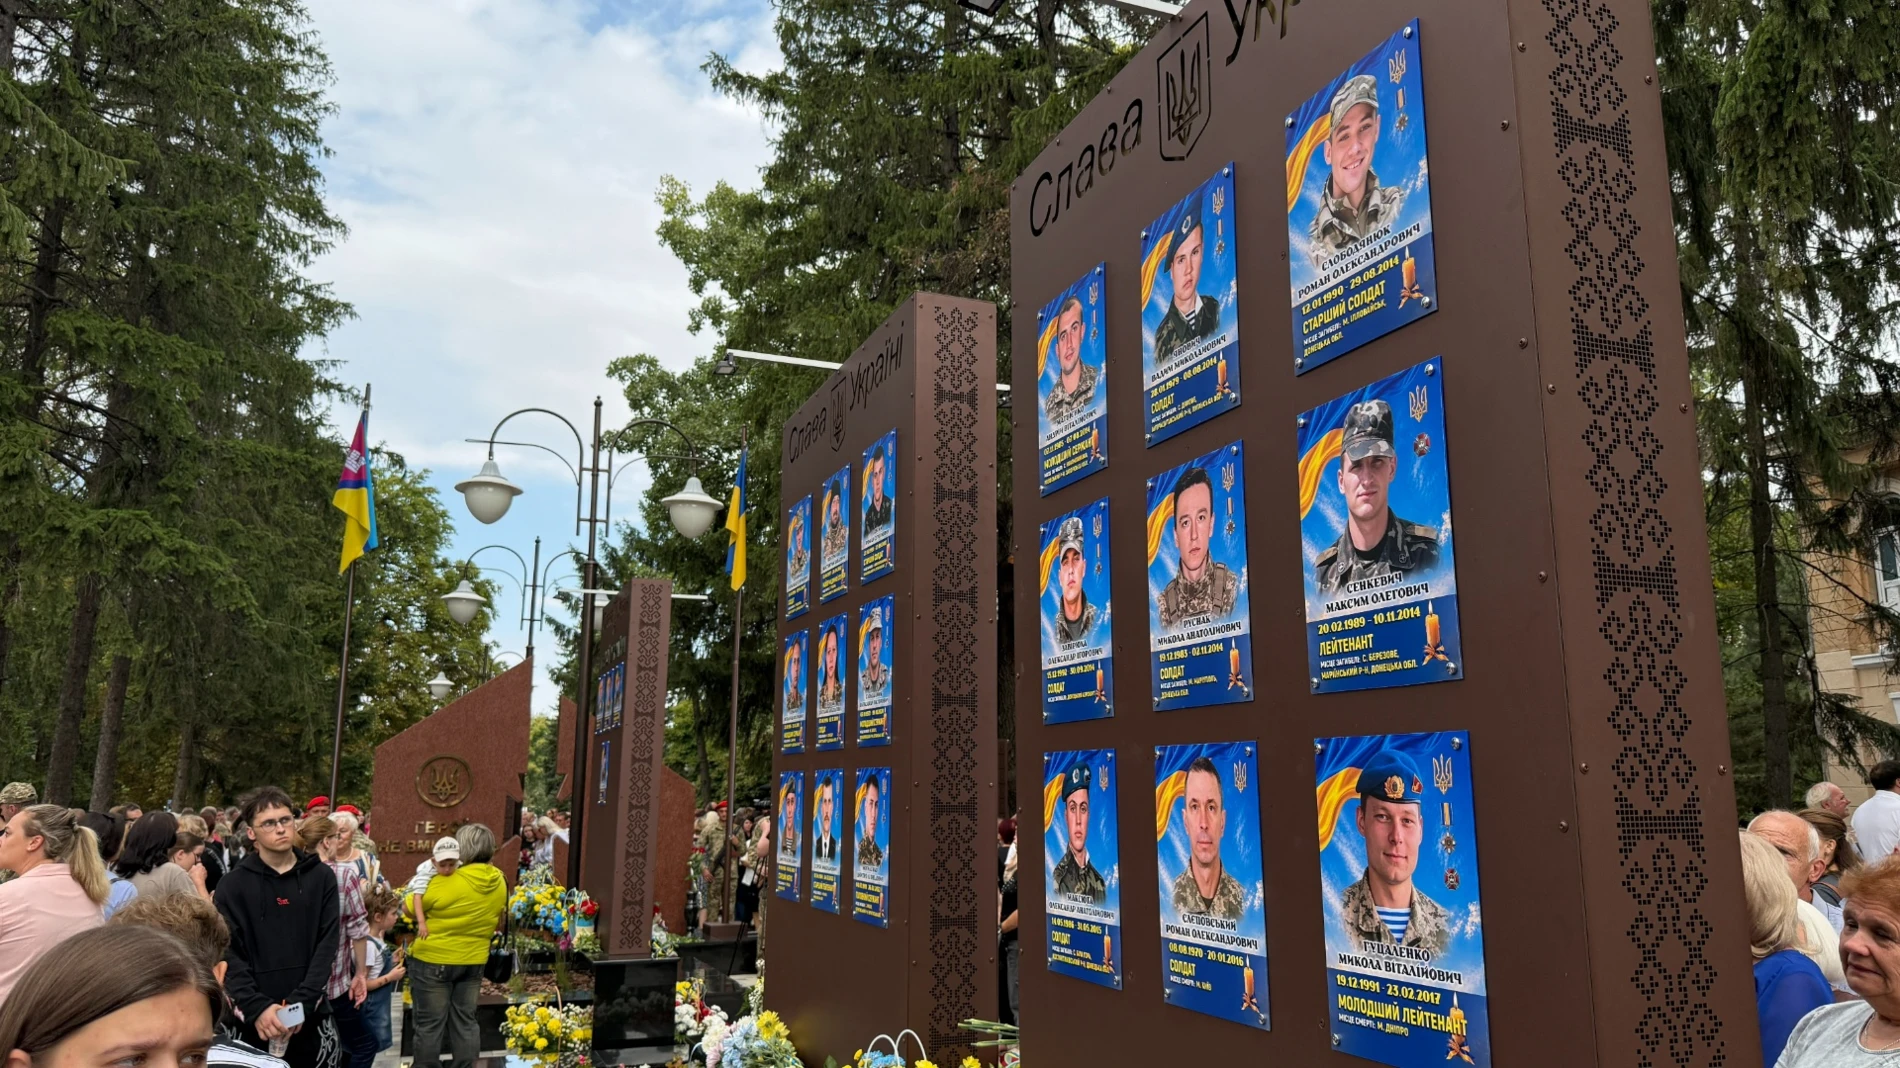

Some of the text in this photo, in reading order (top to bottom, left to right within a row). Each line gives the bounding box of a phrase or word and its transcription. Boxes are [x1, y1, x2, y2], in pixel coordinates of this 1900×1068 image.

[1029, 98, 1143, 237] Слава
[1298, 223, 1421, 299] РОМАН ОЛЕКСАНДРОВИЧ
[1322, 225, 1391, 271] СЛОБОДЯНЮК
[1301, 286, 1344, 315] 12.01.1990
[1350, 255, 1400, 290] 29.08.2014
[1302, 280, 1386, 334] СТАРШИЙ СОЛДАТ
[789, 321, 906, 464] Слава Україні
[1151, 393, 1175, 414] СОЛДАТ
[1346, 572, 1403, 594] СЕНКЕВИЧ
[1325, 583, 1429, 614] МАКСИМ ОЛЕГОВИЧ
[1157, 621, 1242, 646] МИКОЛА АНАТОЛІЙОВИЧ
[1183, 615, 1211, 629] РУСНАК
[1318, 617, 1366, 635] 20.02.1989
[1373, 606, 1421, 625] 10.11.2014
[1319, 634, 1374, 656] ЛЕЙТЕНАНТ
[1160, 665, 1185, 680] СОЛДАТ
[378, 839, 401, 852] НЕ
[1051, 930, 1071, 945] СОЛДАТ
[1165, 924, 1258, 950] РОМАН ОЛЕКСАНДРОВИЧ
[1363, 941, 1431, 962] ГУЦАЛЕНКО
[1169, 958, 1196, 977] СОЛДАТ
[1338, 953, 1463, 985] МИКОЛА ВІТАЛІЙОВИЧ
[1336, 974, 1381, 993] 19.12.1991
[1386, 983, 1441, 1005] 23.02.2017
[1338, 994, 1468, 1036] МОЛОДШИЙ ЛЕЙТЕНАНТ
